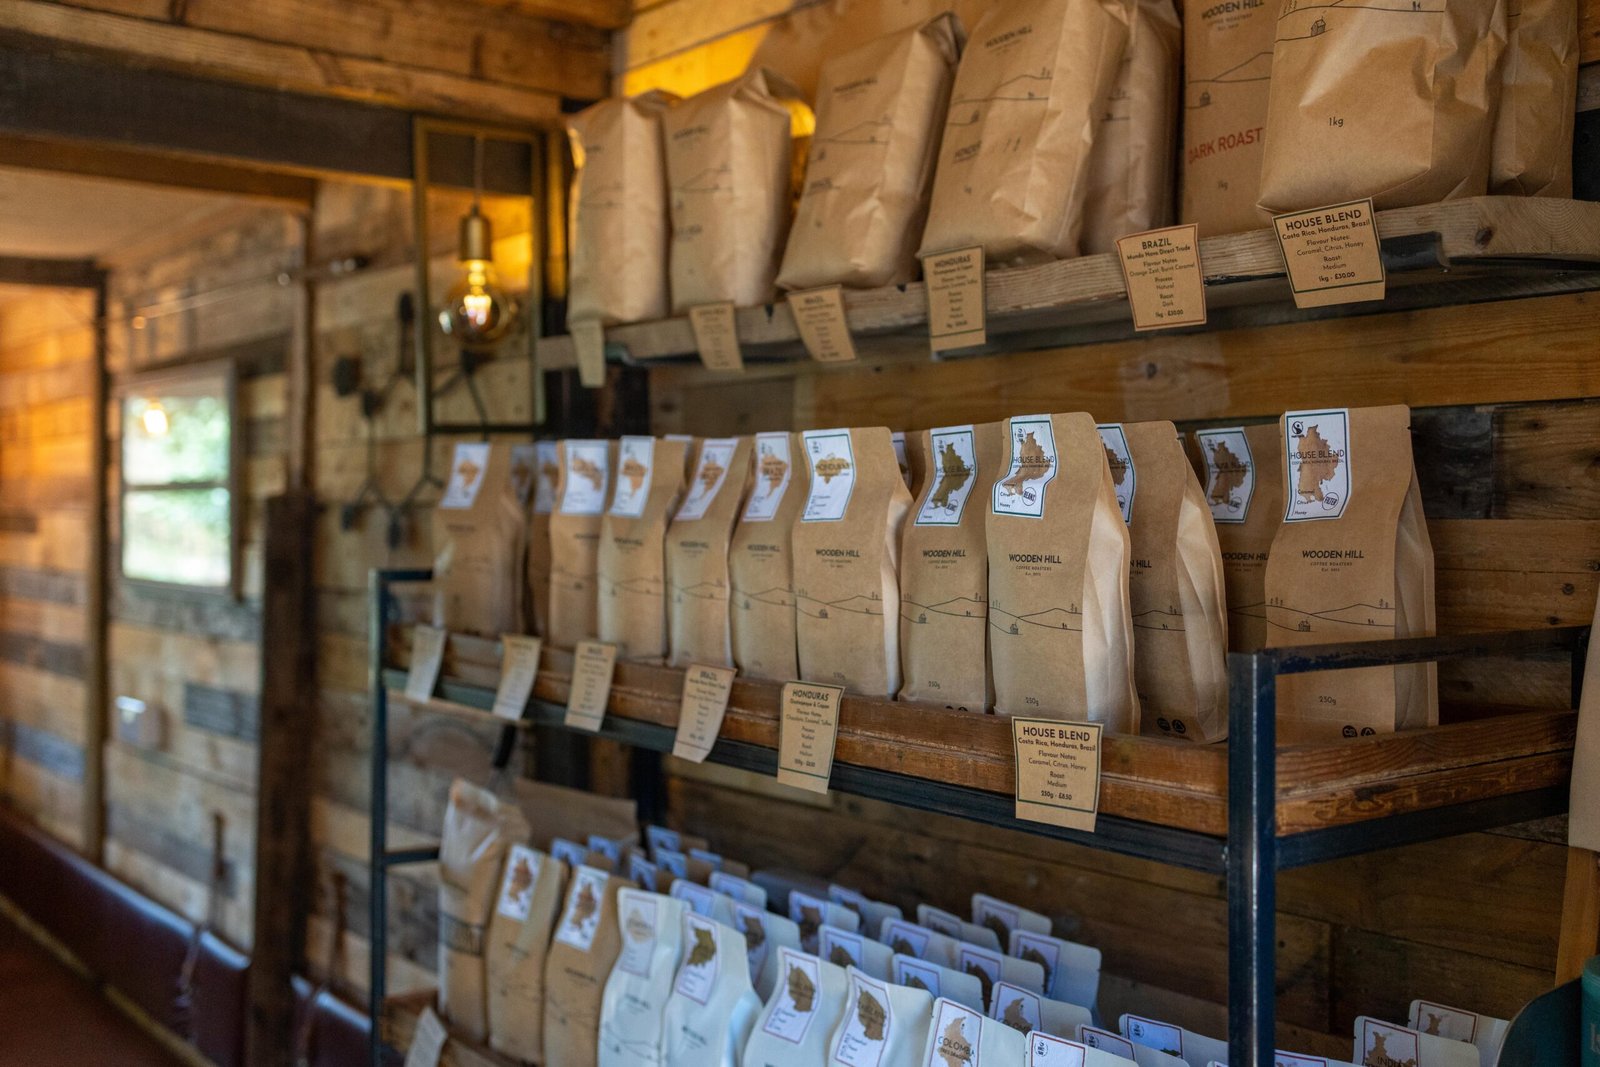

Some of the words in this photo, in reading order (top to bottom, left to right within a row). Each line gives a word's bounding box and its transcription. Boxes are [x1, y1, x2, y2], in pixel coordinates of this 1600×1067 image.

[1202, 1, 1242, 20] WOODEN
[1328, 116, 1344, 128] 1kg
[1218, 127, 1263, 151] ROAST
[1286, 216, 1322, 231] HOUSE
[1325, 209, 1362, 224] BLEND
[1282, 230, 1300, 240] Costa
[1301, 229, 1317, 237] Rica,
[1318, 224, 1350, 234] Honduras,
[1351, 218, 1370, 228] Brazil
[1142, 238, 1172, 250] BRAZIL
[1322, 262, 1346, 270] Medium
[1334, 272, 1356, 280] £30.00
[1013, 456, 1034, 464] HOUSE
[1035, 455, 1055, 464] BLEND
[1290, 450, 1316, 460] HOUSE
[1318, 449, 1345, 459] BLEND
[846, 550, 860, 558] HILL
[1008, 554, 1042, 563] WOODEN
[1044, 554, 1062, 564] HILL
[1302, 550, 1342, 559] WOODEN
[1344, 550, 1364, 559] HILL
[1136, 560, 1152, 568] HILL
[792, 689, 830, 702] HONDURAS
[1319, 696, 1336, 706] 250g
[1022, 726, 1056, 738] HOUSE
[1058, 730, 1090, 742] BLEND
[1018, 737, 1034, 745] Costa
[1050, 740, 1078, 751] Honduras,
[1080, 744, 1096, 752] Brazil
[1038, 750, 1058, 758] Flavour
[1070, 763, 1087, 772] Honey
[1047, 780, 1067, 788] Medium
[1040, 790, 1054, 799] 250g
